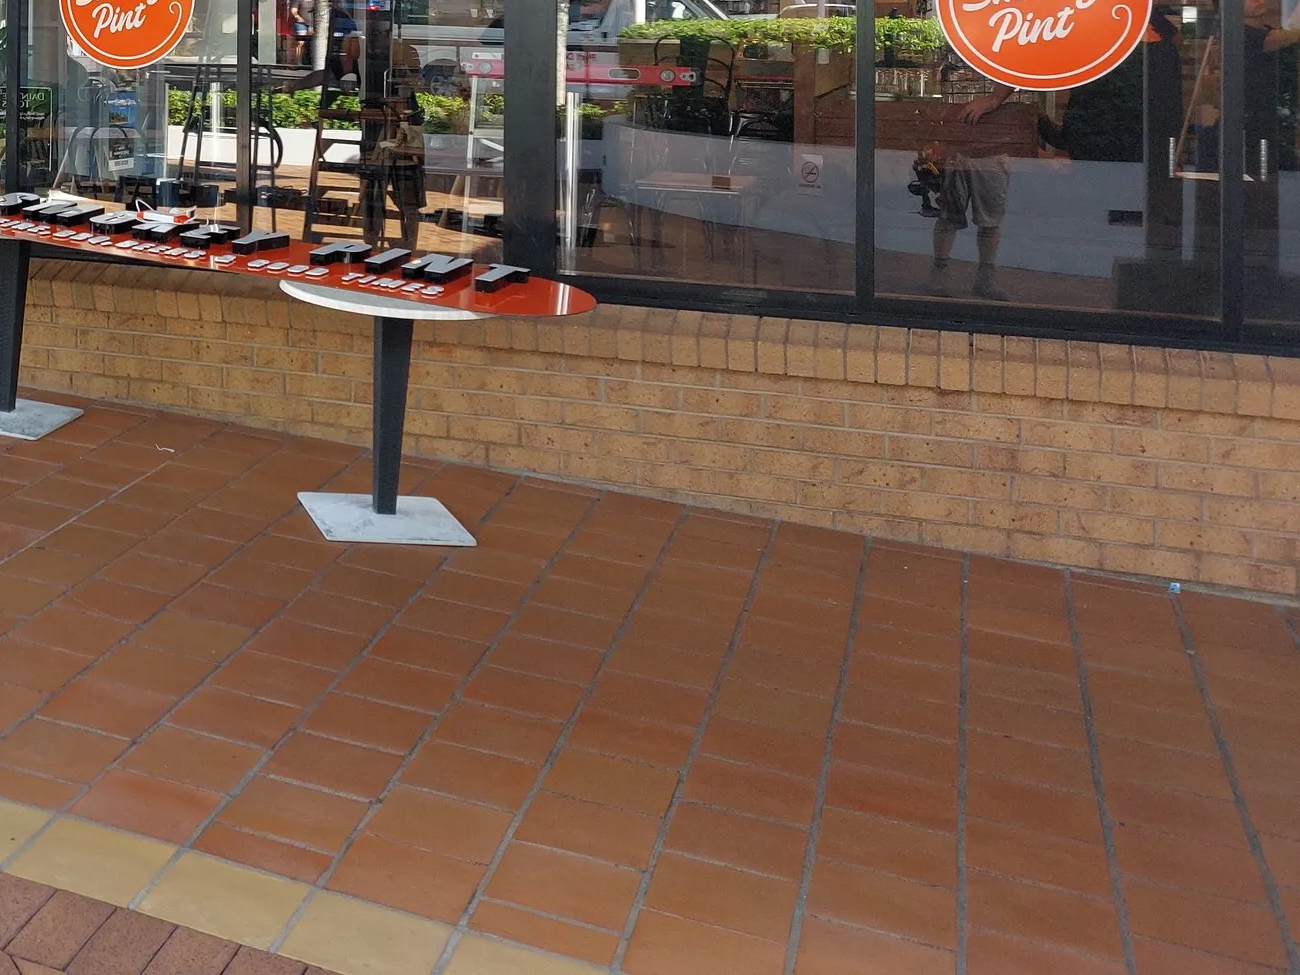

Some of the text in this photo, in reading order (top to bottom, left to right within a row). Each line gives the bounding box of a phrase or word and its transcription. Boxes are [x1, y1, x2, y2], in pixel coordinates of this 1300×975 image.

[91, 2, 147, 39] Pint
[988, 5, 1075, 53] Pint
[247, 259, 329, 277] GOOD
[341, 272, 445, 296] TIMES
[309, 242, 531, 293] PINT
